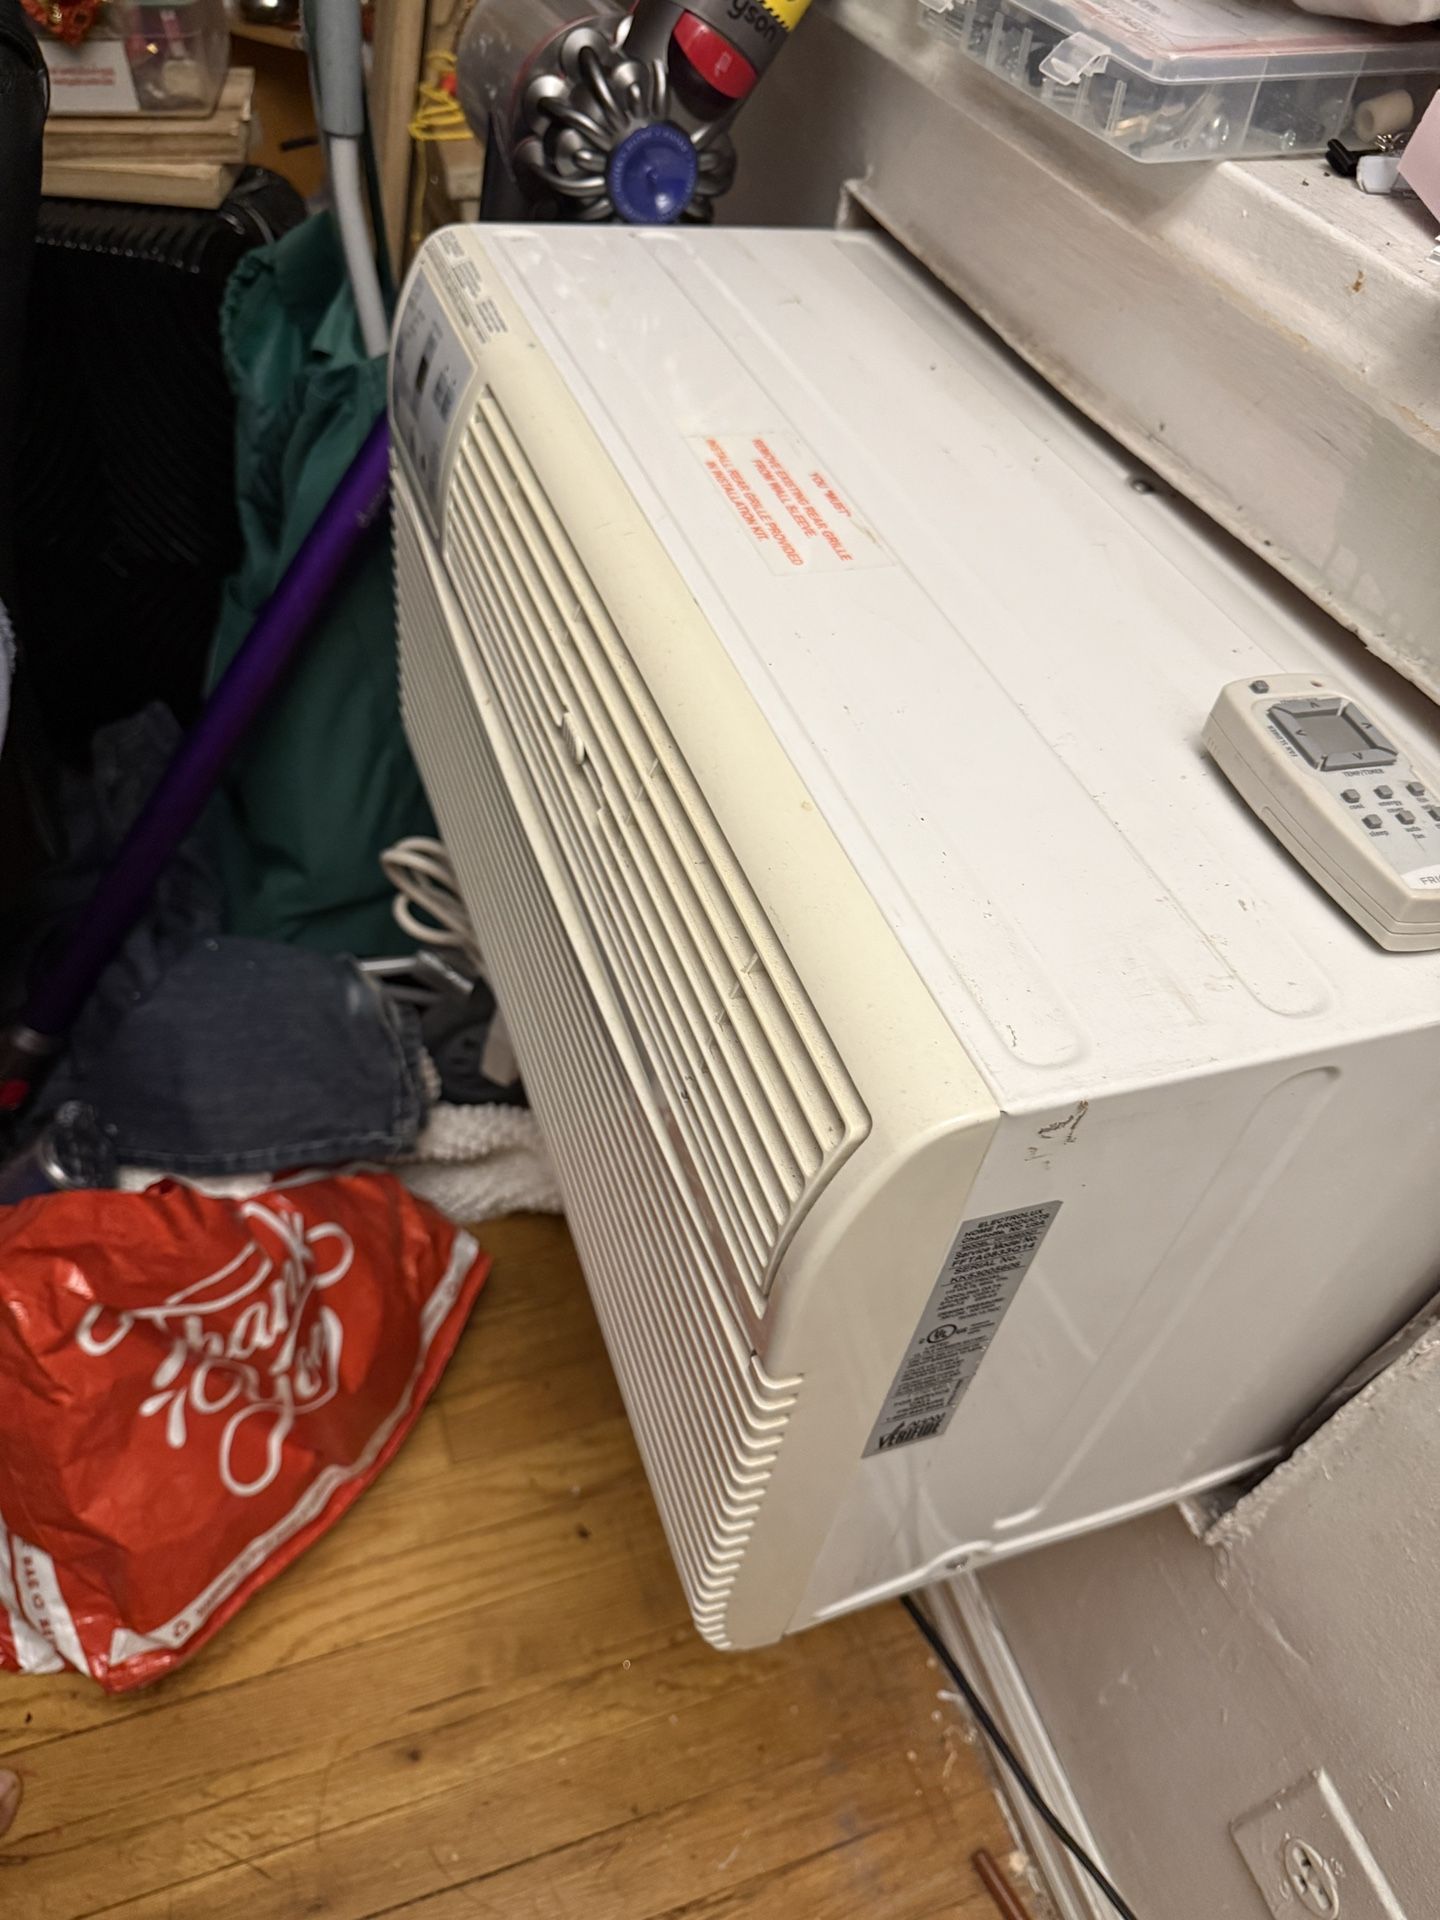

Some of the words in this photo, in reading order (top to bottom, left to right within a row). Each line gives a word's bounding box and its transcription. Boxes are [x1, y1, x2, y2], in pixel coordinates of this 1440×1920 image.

[706, 439, 732, 468] INSTALL
[729, 469, 751, 492] REAR
[744, 492, 772, 523] GRILLE
[768, 522, 804, 566] PROVIDED
[713, 470, 758, 526] INSTALLATION
[753, 459, 775, 481] FROM
[770, 482, 791, 504] WALL
[753, 439, 780, 469] REMOVE
[776, 470, 810, 505] EXISTING
[804, 506, 828, 530] REAR
[822, 530, 853, 561] GRILLE
[810, 472, 827, 489] YOU
[1419, 874, 1440, 885] FRI
[76, 1202, 354, 1388] Thank
